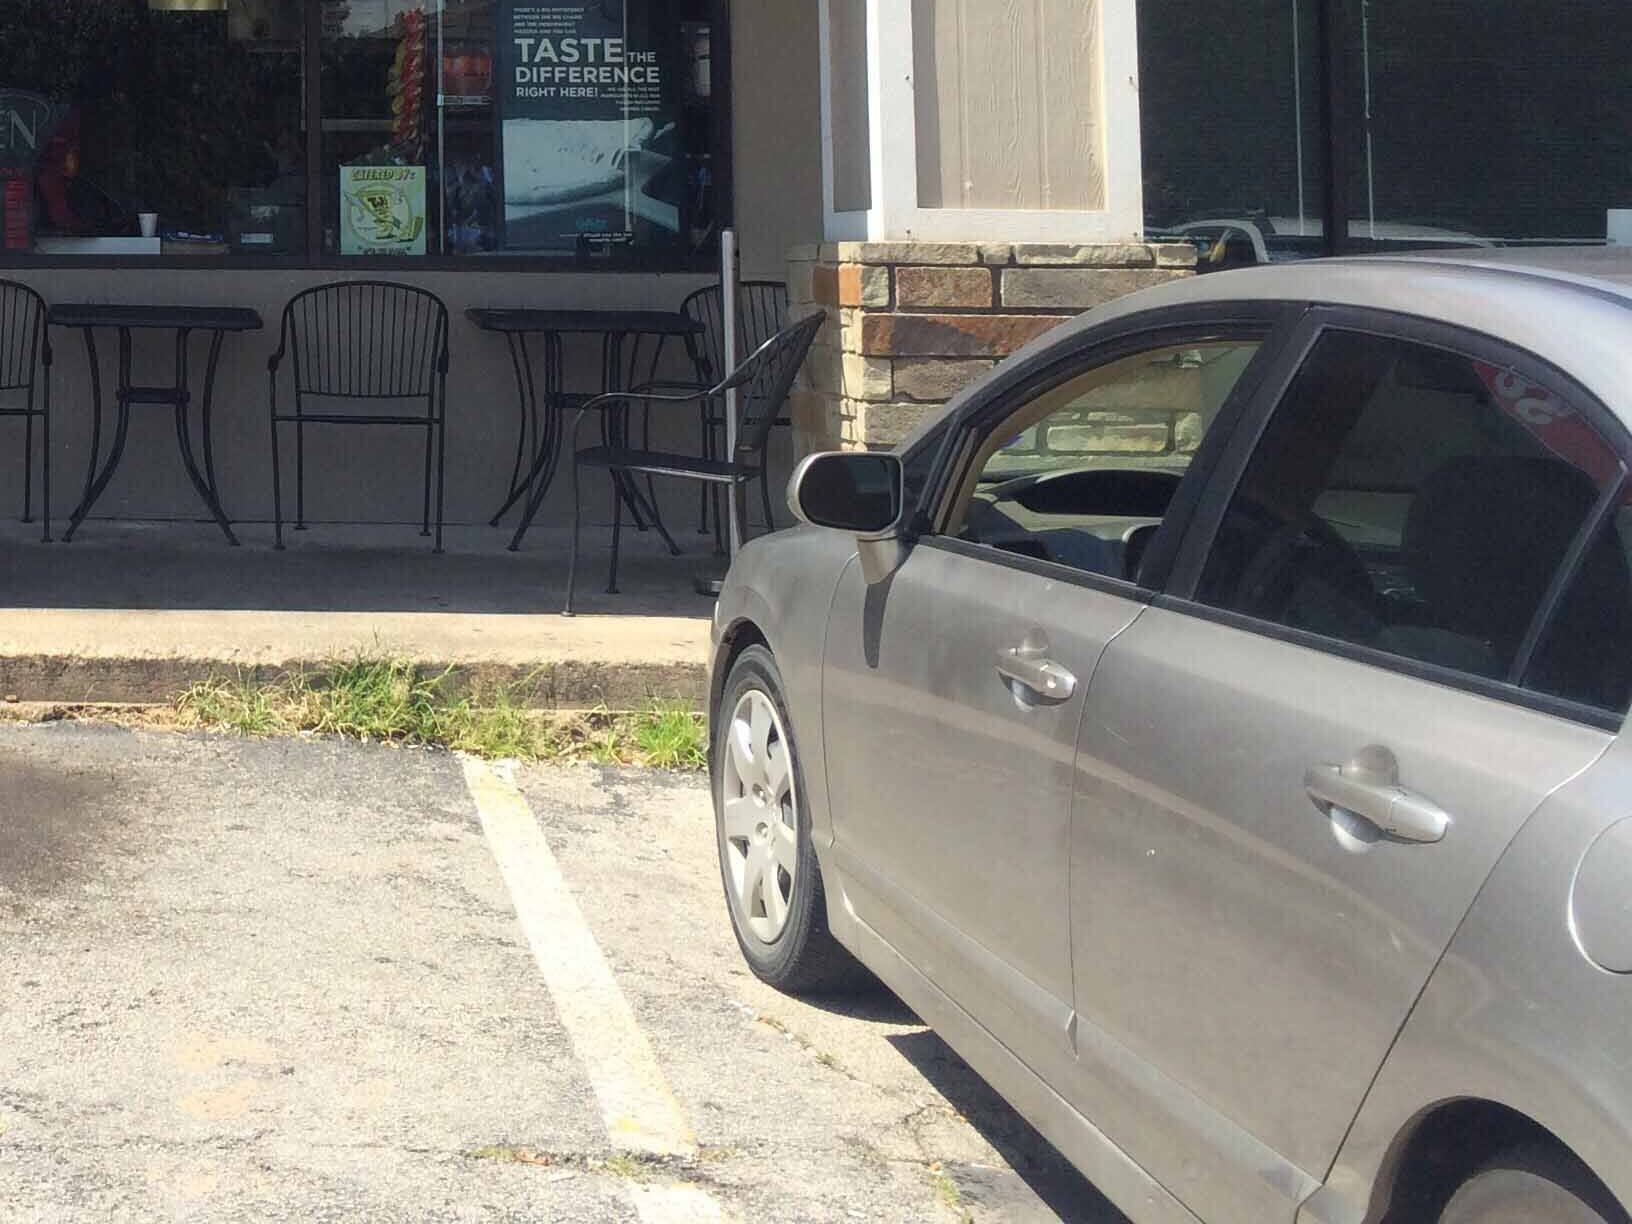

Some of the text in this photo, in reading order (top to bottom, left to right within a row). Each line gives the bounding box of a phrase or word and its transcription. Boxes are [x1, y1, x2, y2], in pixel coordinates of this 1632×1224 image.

[514, 38, 657, 63] TASTE THE
[515, 66, 660, 83] DIFFERENCE
[516, 87, 599, 97] RIGHT HERE!
